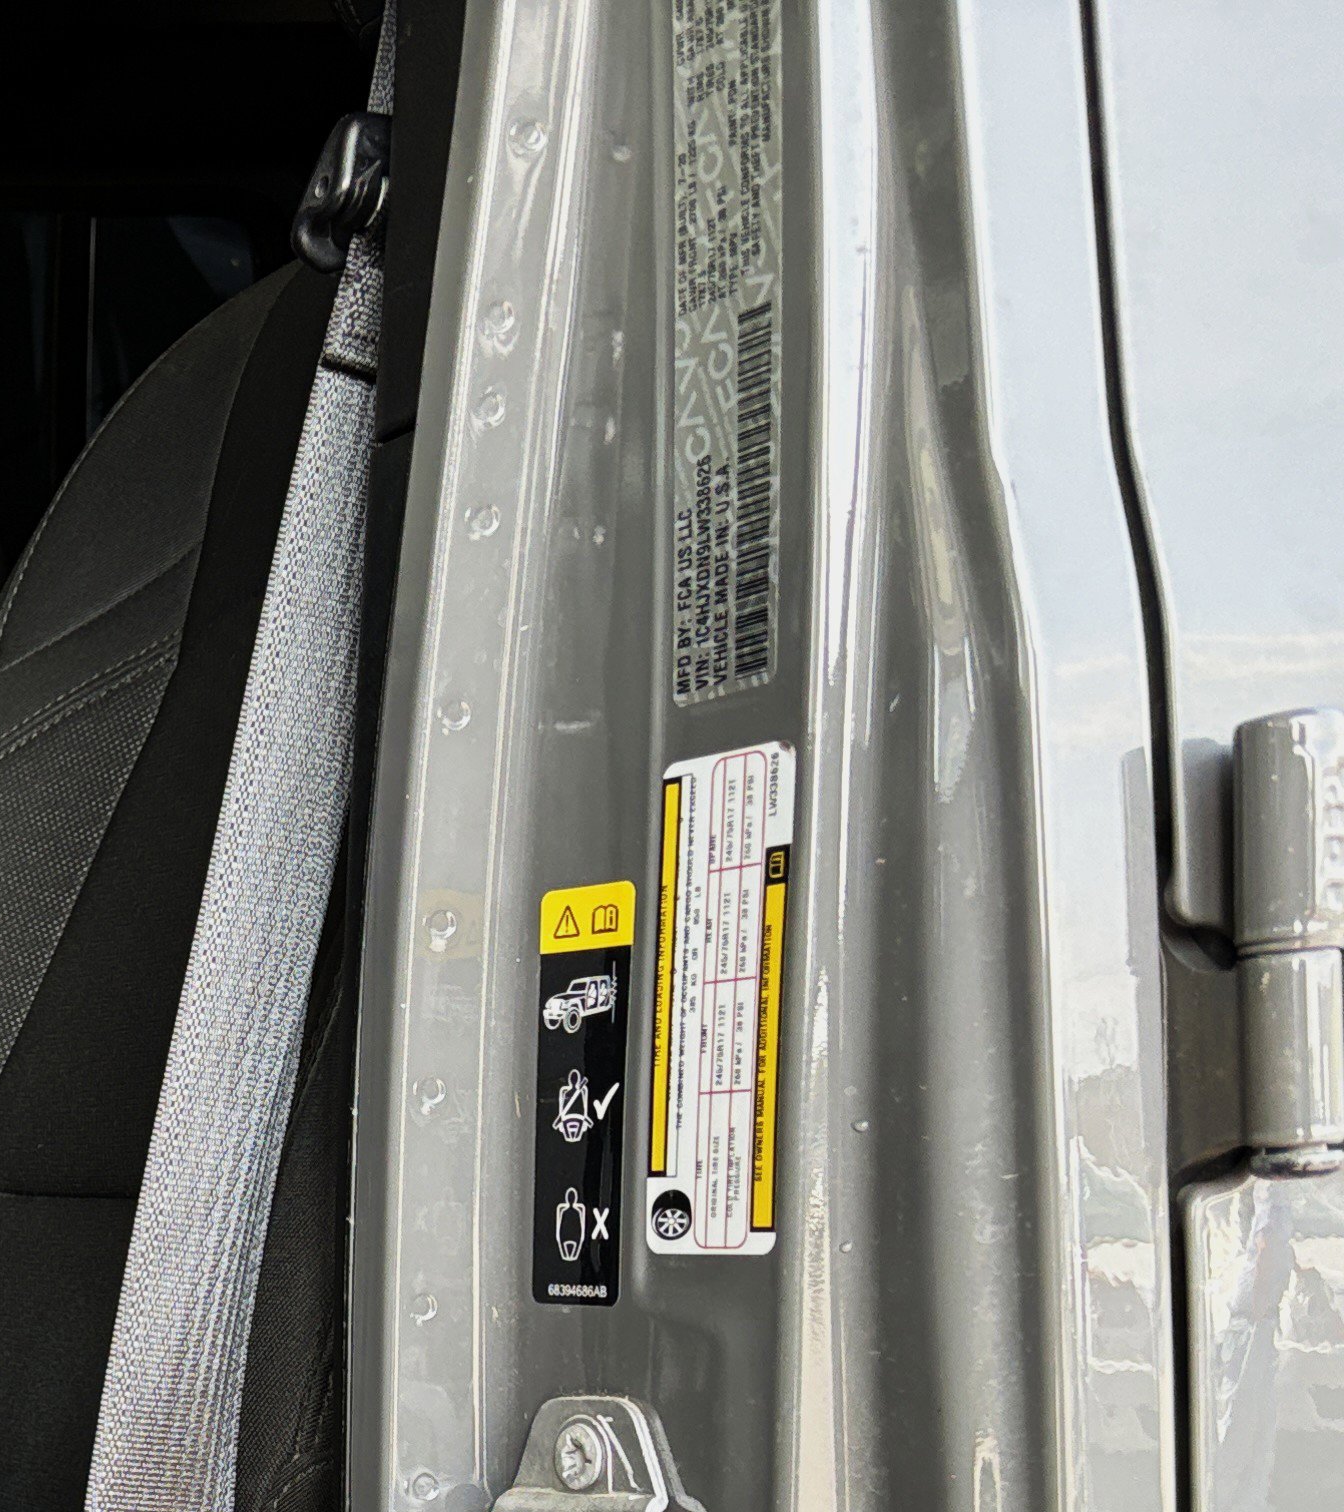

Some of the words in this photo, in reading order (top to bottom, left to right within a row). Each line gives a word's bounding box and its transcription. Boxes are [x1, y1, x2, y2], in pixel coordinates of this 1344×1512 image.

[714, 457, 729, 515] U.S.A.
[678, 508, 692, 541] LLC
[714, 519, 728, 547] IN:
[678, 546, 691, 572] US
[714, 551, 728, 605] MADE
[678, 576, 691, 611] FCA
[678, 619, 691, 649] BY:
[713, 609, 727, 686] VEHICLE
[677, 655, 691, 695] MFD
[695, 652, 709, 691] VIN:
[768, 752, 779, 817] LW338626
